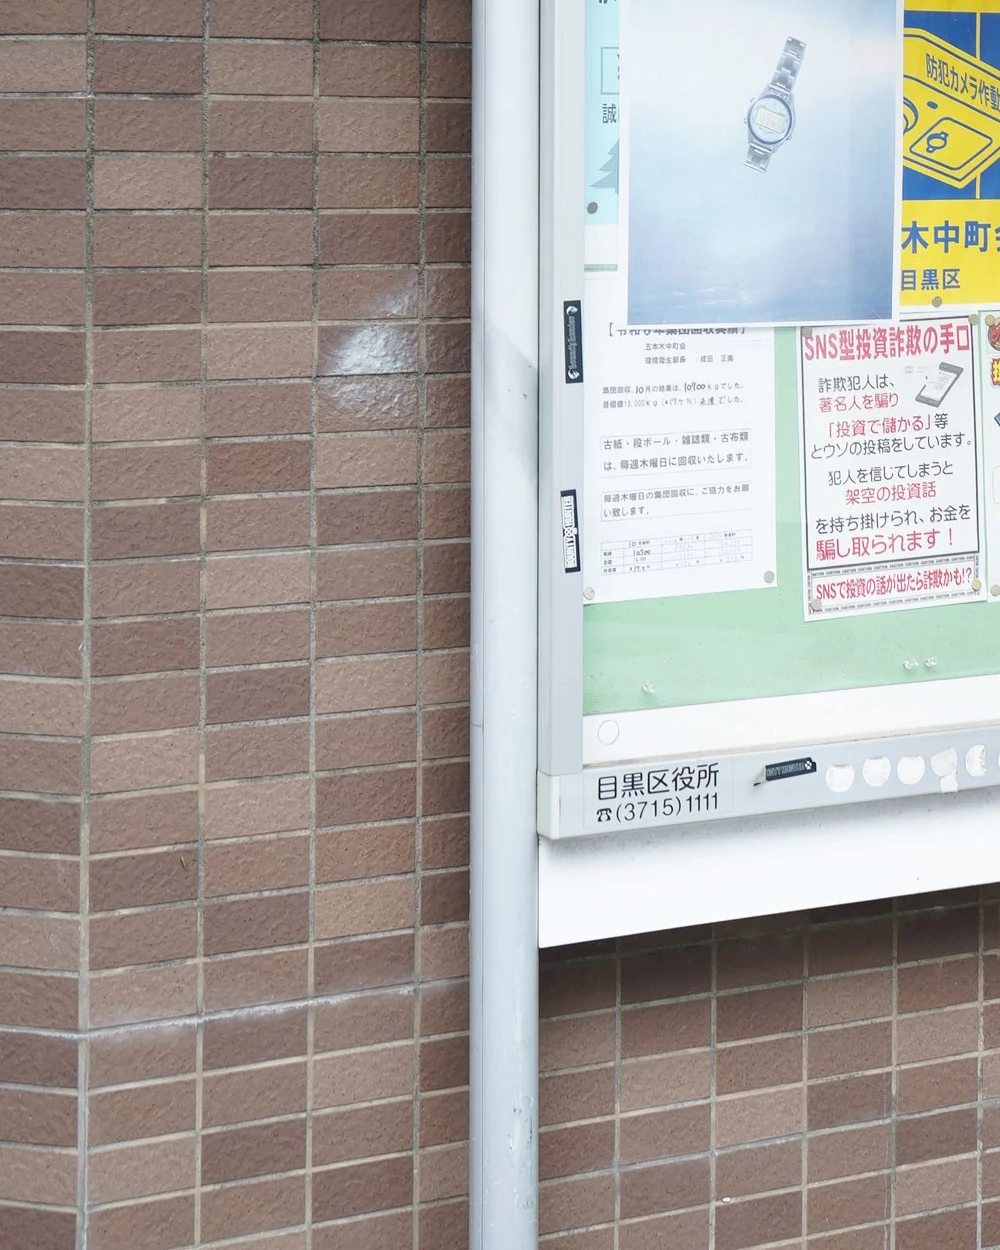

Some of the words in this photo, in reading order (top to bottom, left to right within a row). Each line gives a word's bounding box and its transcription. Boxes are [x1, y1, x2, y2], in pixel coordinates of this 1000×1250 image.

[901, 268, 961, 291] 目黒区
[804, 323, 970, 361] SNS型投資詐欺の手口
[818, 374, 895, 393] 詐欺犯人は、
[819, 392, 899, 413] 著名人を騙り
[829, 413, 949, 439] 「投資で儲かる」等
[811, 432, 972, 460] とウソの投稿をしています。
[828, 461, 953, 486] 犯人を信じてしまうと
[845, 481, 937, 505] 架空の投資話
[815, 504, 971, 535] を持ち掛けられ、お金を
[598, 762, 720, 801] 目黒区役所
